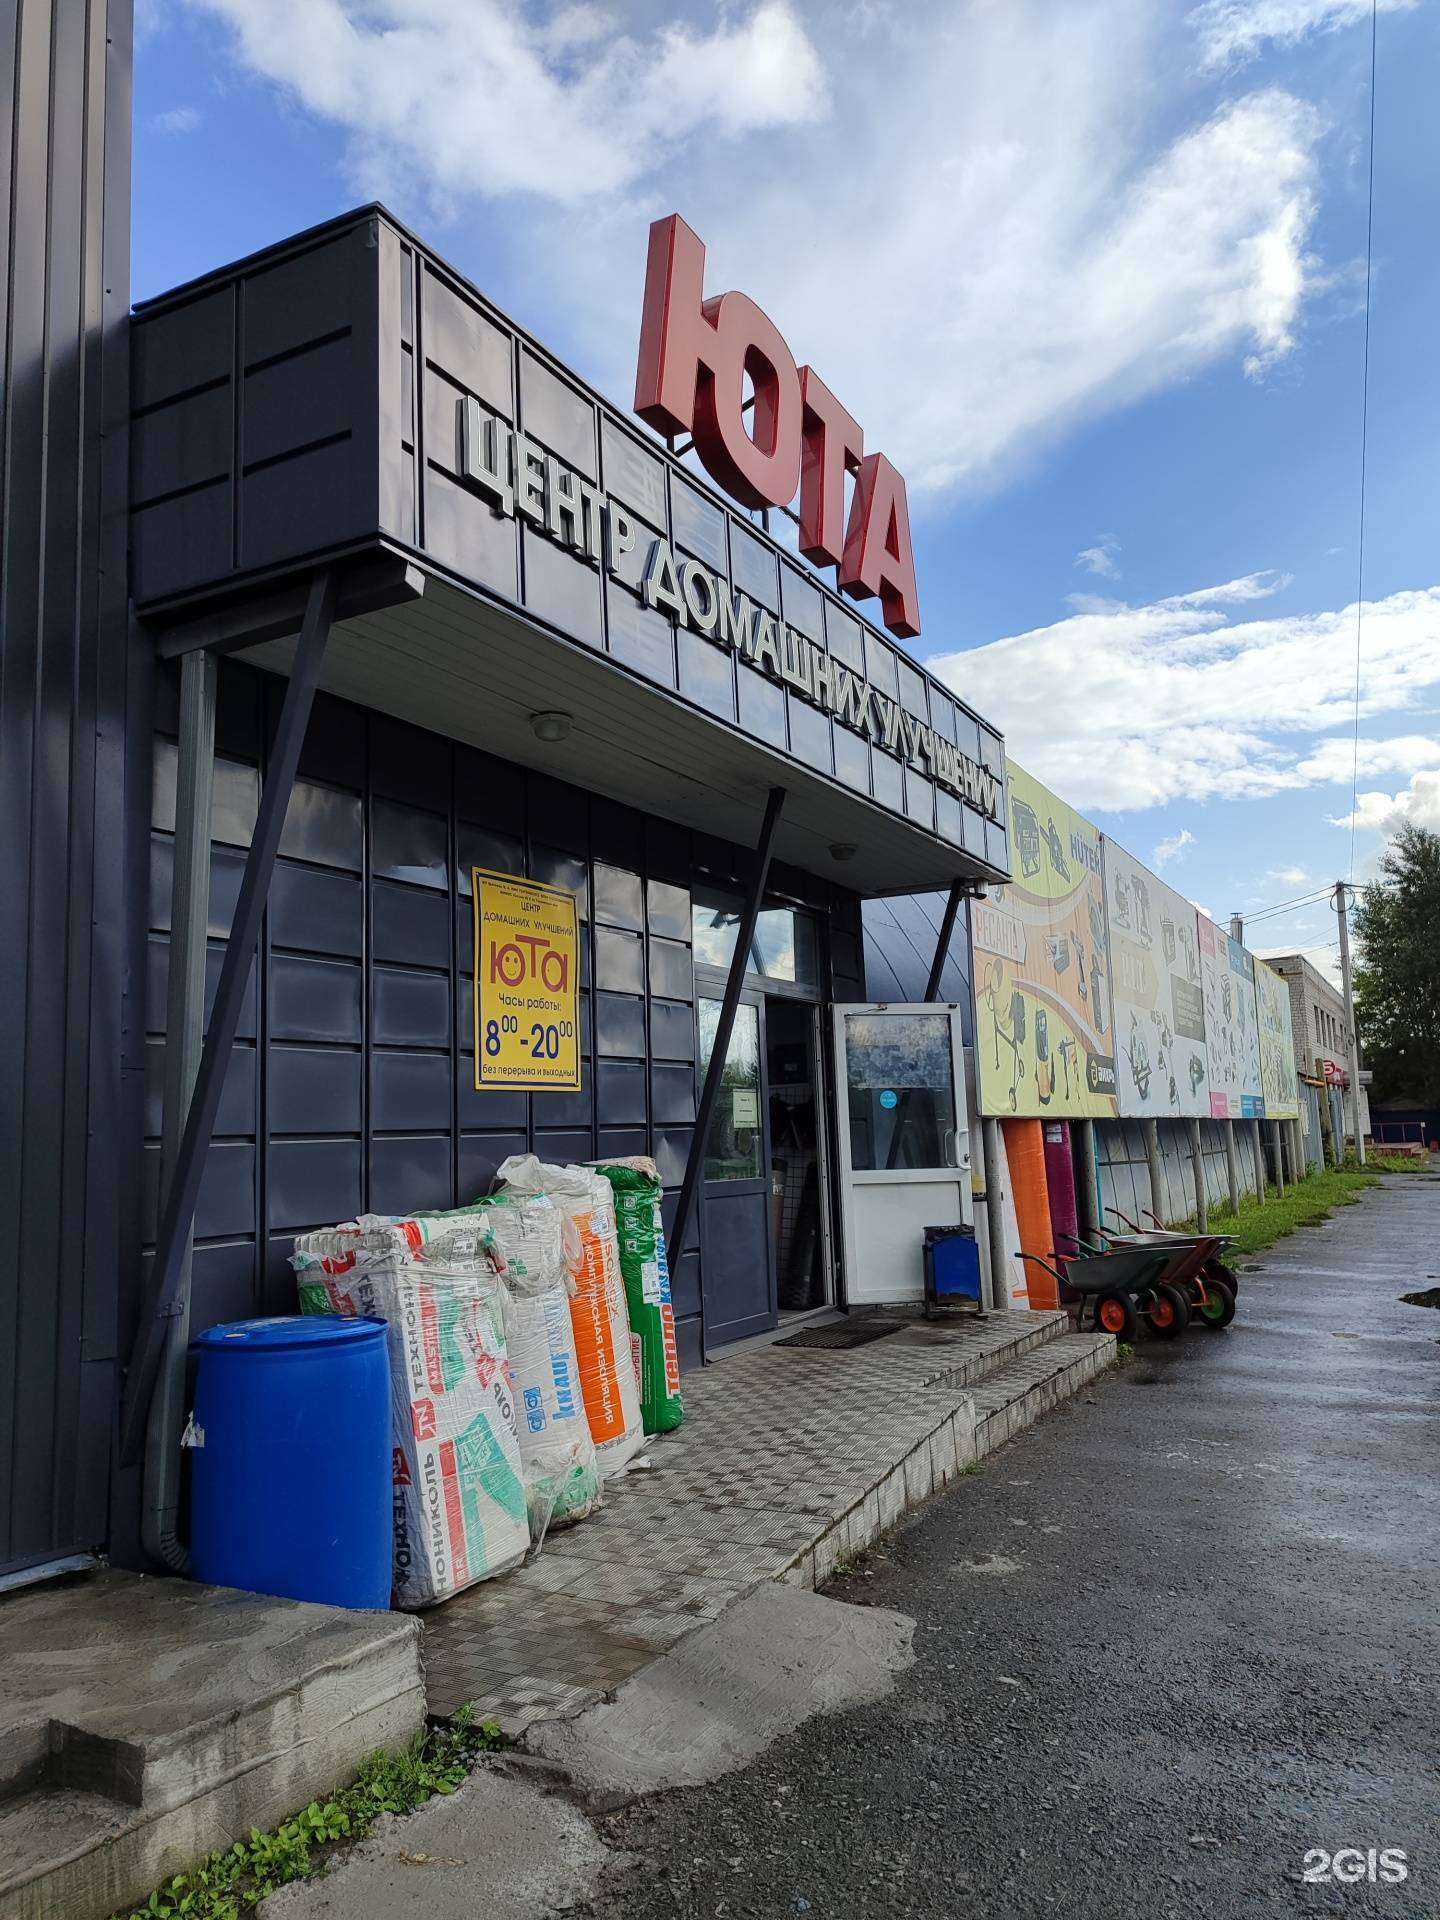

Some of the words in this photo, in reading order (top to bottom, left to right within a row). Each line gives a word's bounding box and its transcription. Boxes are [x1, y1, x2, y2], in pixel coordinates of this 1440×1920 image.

[634, 213, 921, 639] ЮТА
[456, 395, 635, 574] ЦЕНТР
[638, 539, 878, 736] ДОМАШНИХ
[871, 692, 998, 820] УЛУЧШЕНИЙ
[520, 901, 541, 913] ЦЕНТР
[483, 911, 530, 928] ДОМАШНИХ
[533, 920, 574, 937] УЛУЧШЕНИЙ
[498, 992, 526, 1007] Часы
[482, 1063, 497, 1074] без
[497, 1066, 536, 1077] перерыва
[542, 1068, 575, 1077] выходных
